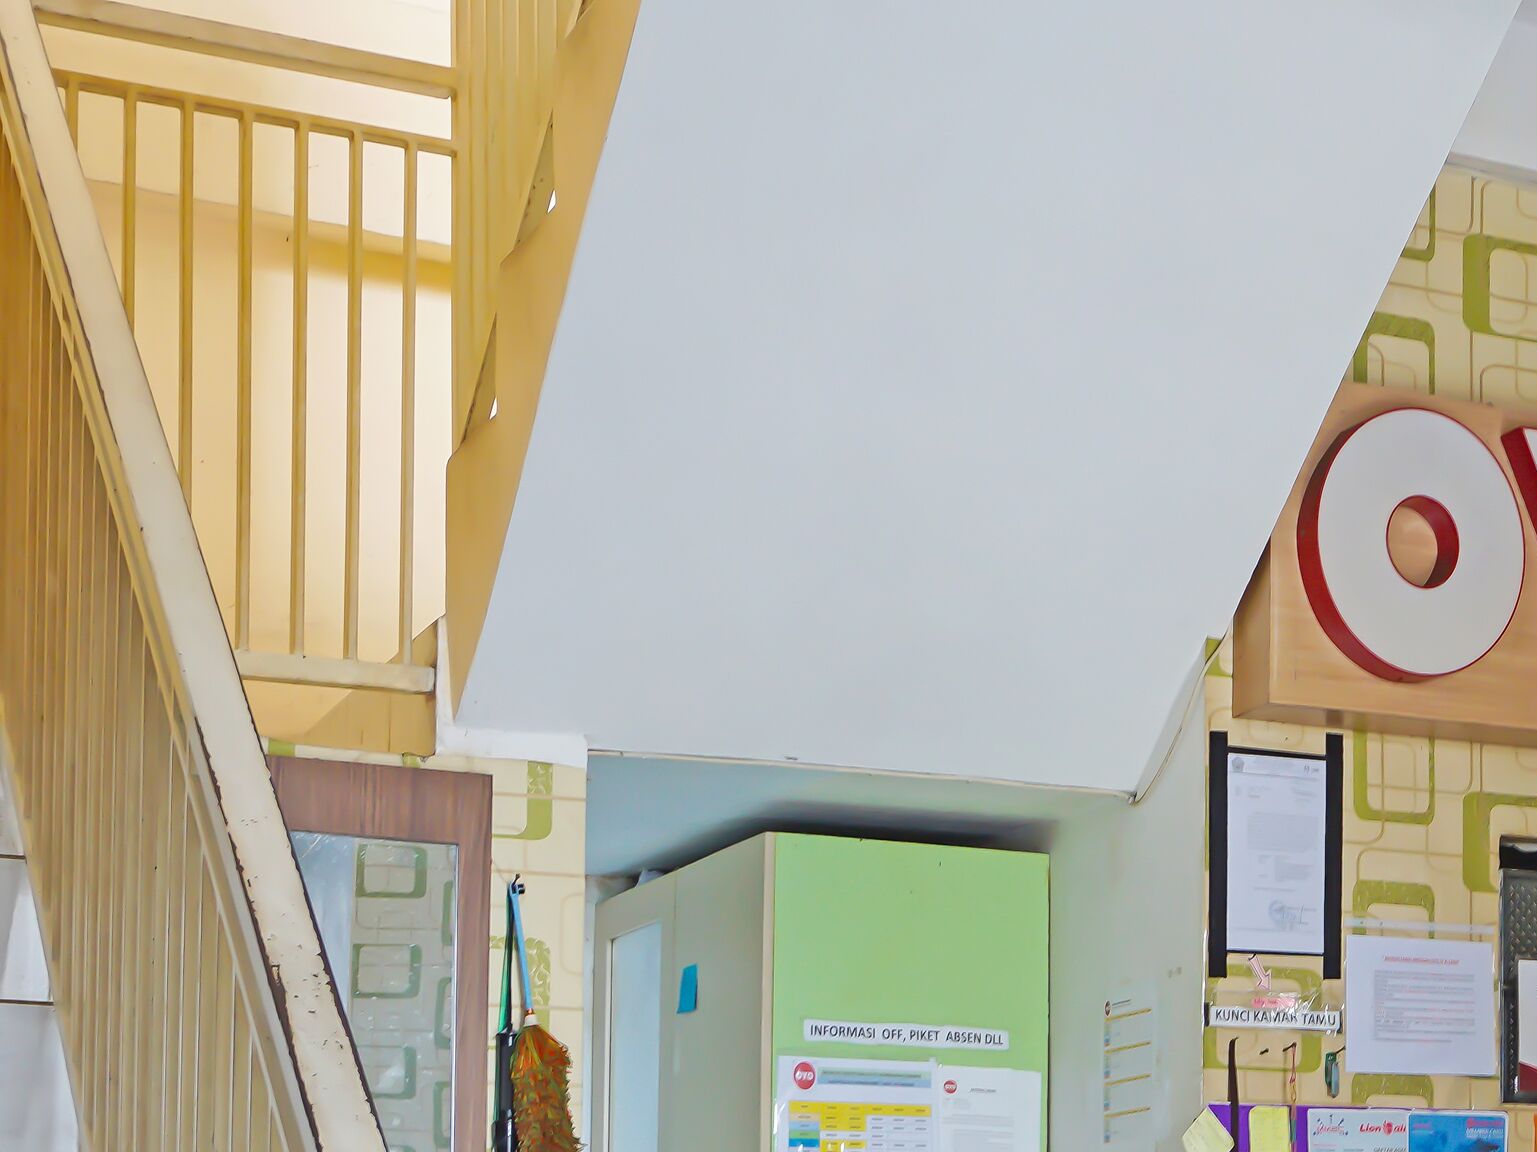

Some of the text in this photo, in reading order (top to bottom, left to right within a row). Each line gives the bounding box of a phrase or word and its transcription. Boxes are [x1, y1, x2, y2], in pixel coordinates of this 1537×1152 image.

[1215, 1008, 1337, 1026] KUNCI KAMAR TAMU
[810, 1024, 1004, 1046] INFORMASI OFF, PIKET ABSEN DLL
